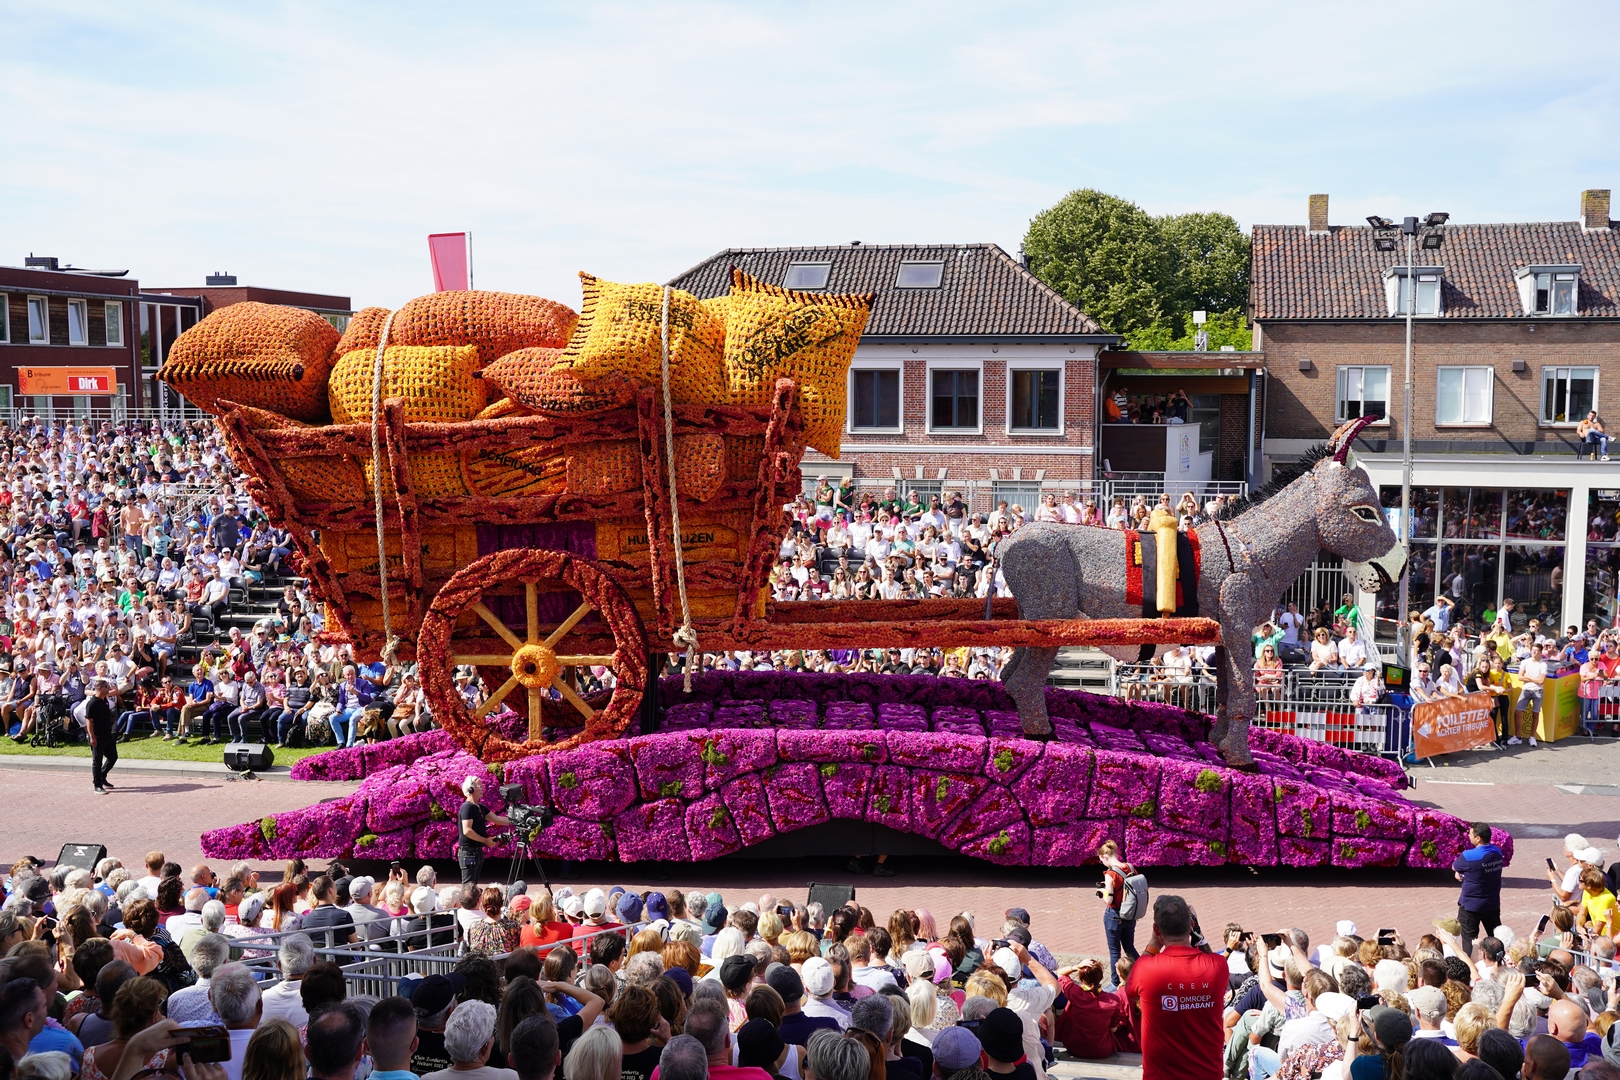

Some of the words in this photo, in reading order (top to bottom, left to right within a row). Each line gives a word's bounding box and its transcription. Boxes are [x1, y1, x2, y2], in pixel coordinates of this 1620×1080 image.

[27, 369, 33, 378] B
[78, 377, 98, 390] Dirk
[478, 448, 543, 476] SCHEIDING
[1436, 726, 1461, 737] ACHTER
[1462, 720, 1489, 732] TRIBUNE
[1179, 995, 1211, 1003] OMROEP
[1180, 1001, 1215, 1010] BRABANT
